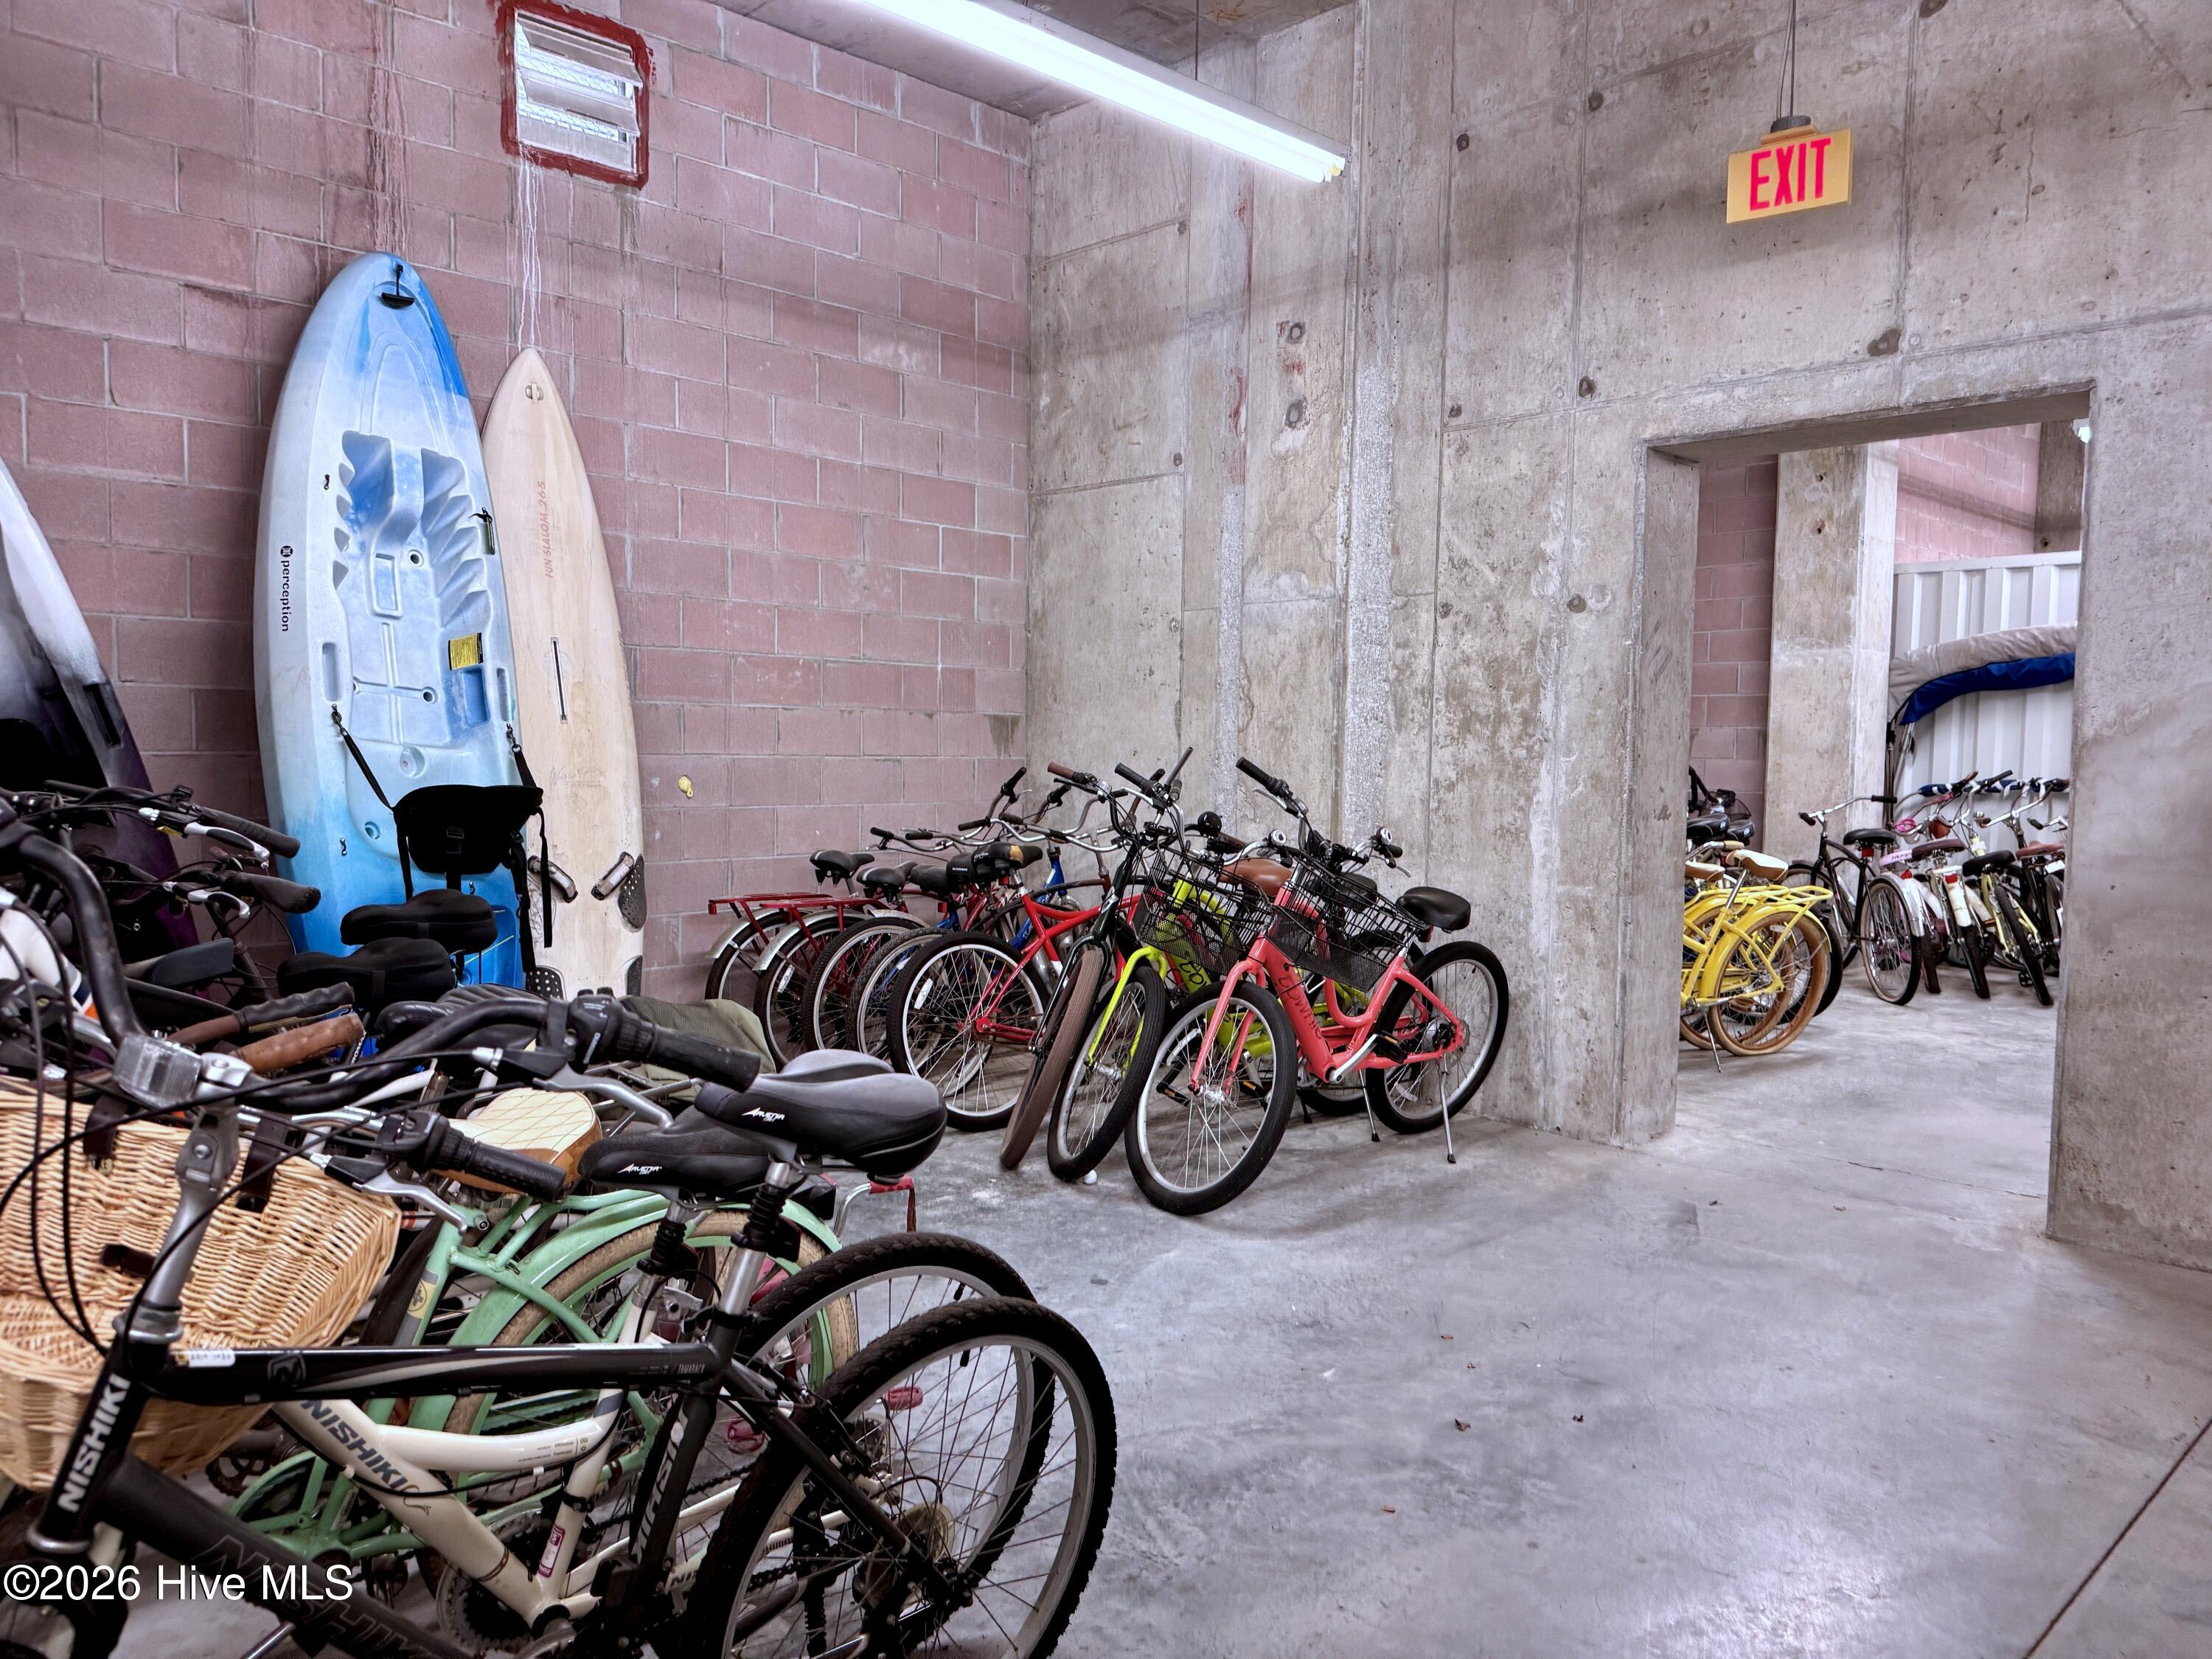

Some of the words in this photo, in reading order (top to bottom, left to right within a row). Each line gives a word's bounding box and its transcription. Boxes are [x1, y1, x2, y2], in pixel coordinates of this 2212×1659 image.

[1749, 137, 1832, 212] EXIT
[538, 481, 546, 508] 265
[540, 512, 552, 556] SLALOM
[544, 558, 554, 578] FUN
[280, 560, 292, 632] perception
[57, 1372, 131, 1512] NISHIKI
[300, 1400, 408, 1489] NISHIKI
[637, 1405, 689, 1565] ISHIK
